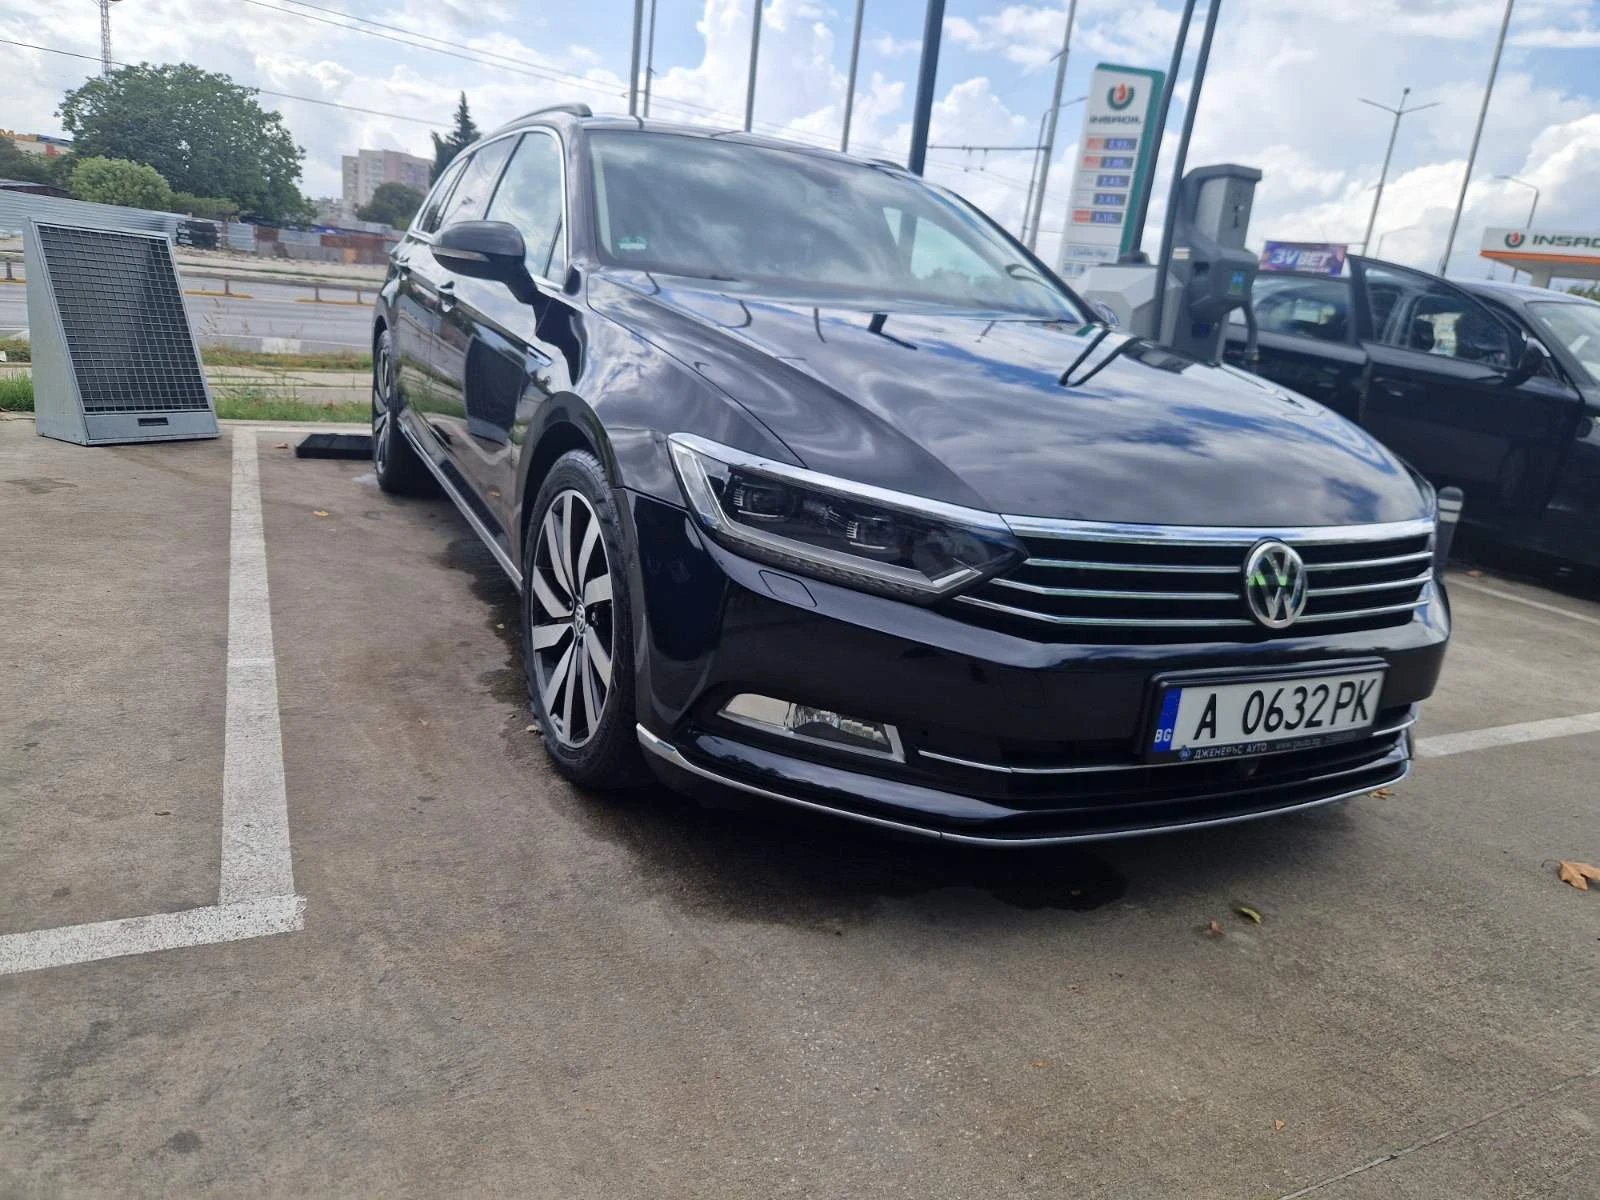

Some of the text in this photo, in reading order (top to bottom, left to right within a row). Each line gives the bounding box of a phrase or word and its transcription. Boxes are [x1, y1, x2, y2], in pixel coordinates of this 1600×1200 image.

[1193, 678, 1377, 740] A 0632PK
[1154, 728, 1172, 743] BG
